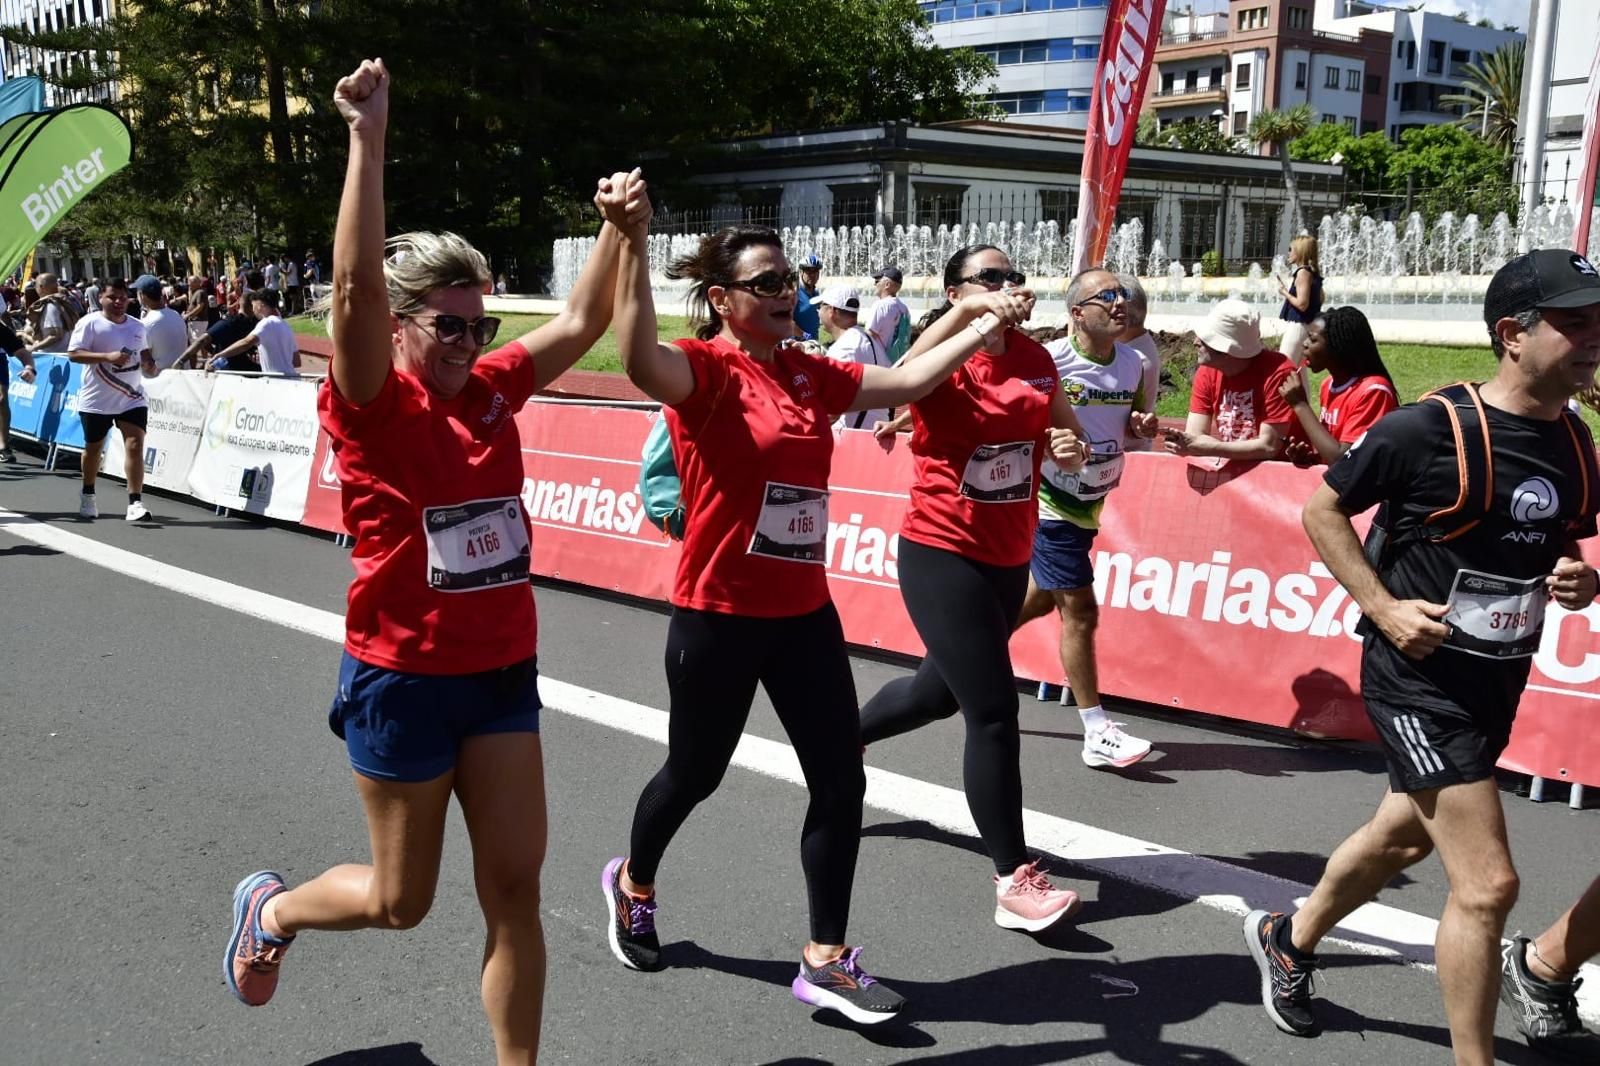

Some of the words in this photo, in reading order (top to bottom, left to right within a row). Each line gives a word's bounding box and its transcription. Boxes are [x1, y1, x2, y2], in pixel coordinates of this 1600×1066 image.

[20, 146, 105, 233] Binter
[279, 440, 310, 456] Deporte
[990, 464, 1011, 482] 4167
[466, 531, 500, 559] 4166
[1501, 530, 1547, 545] ANFI
[1490, 611, 1528, 631] 3786
